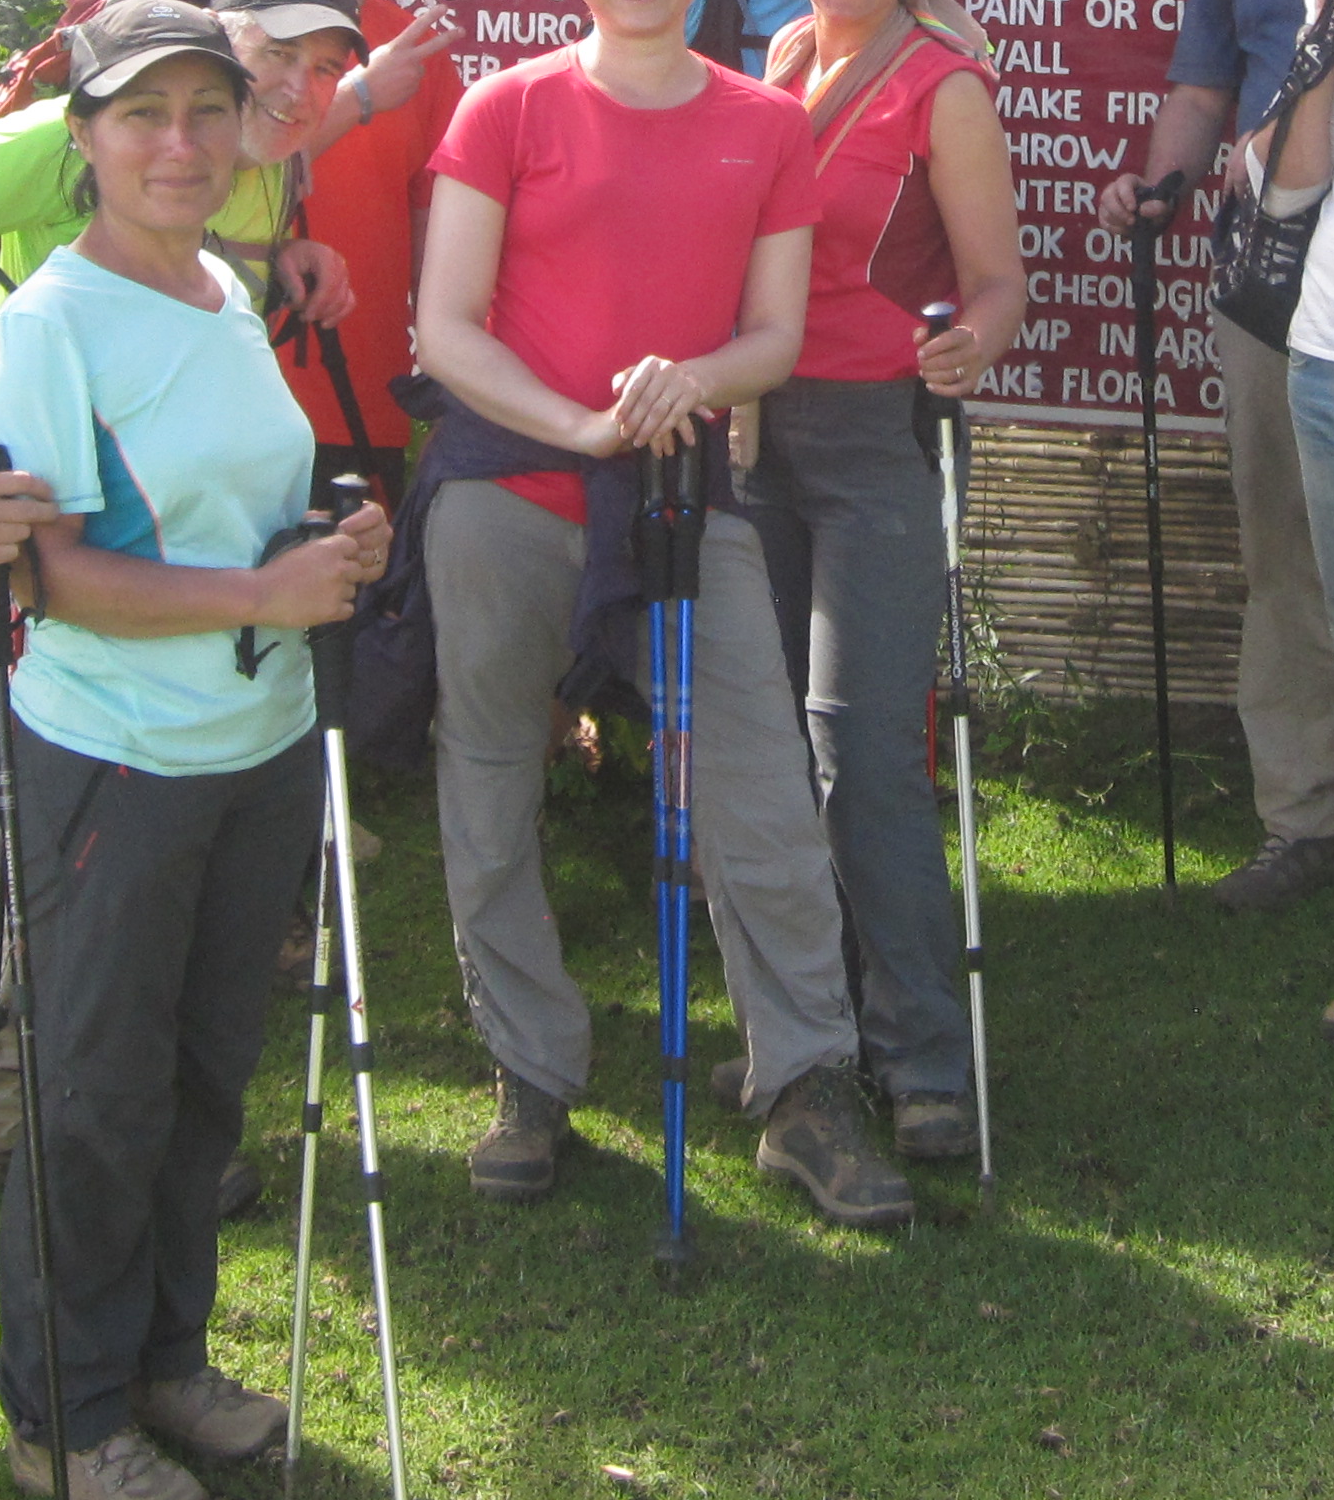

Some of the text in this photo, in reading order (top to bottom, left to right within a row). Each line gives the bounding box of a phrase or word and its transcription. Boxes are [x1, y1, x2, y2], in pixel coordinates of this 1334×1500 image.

[995, 85, 1169, 125] MAKE FIR
[1006, 132, 1128, 170] HROW
[1155, 233, 1215, 269] LUN
[1099, 322, 1136, 358] IN
[973, 362, 1044, 399] AKE
